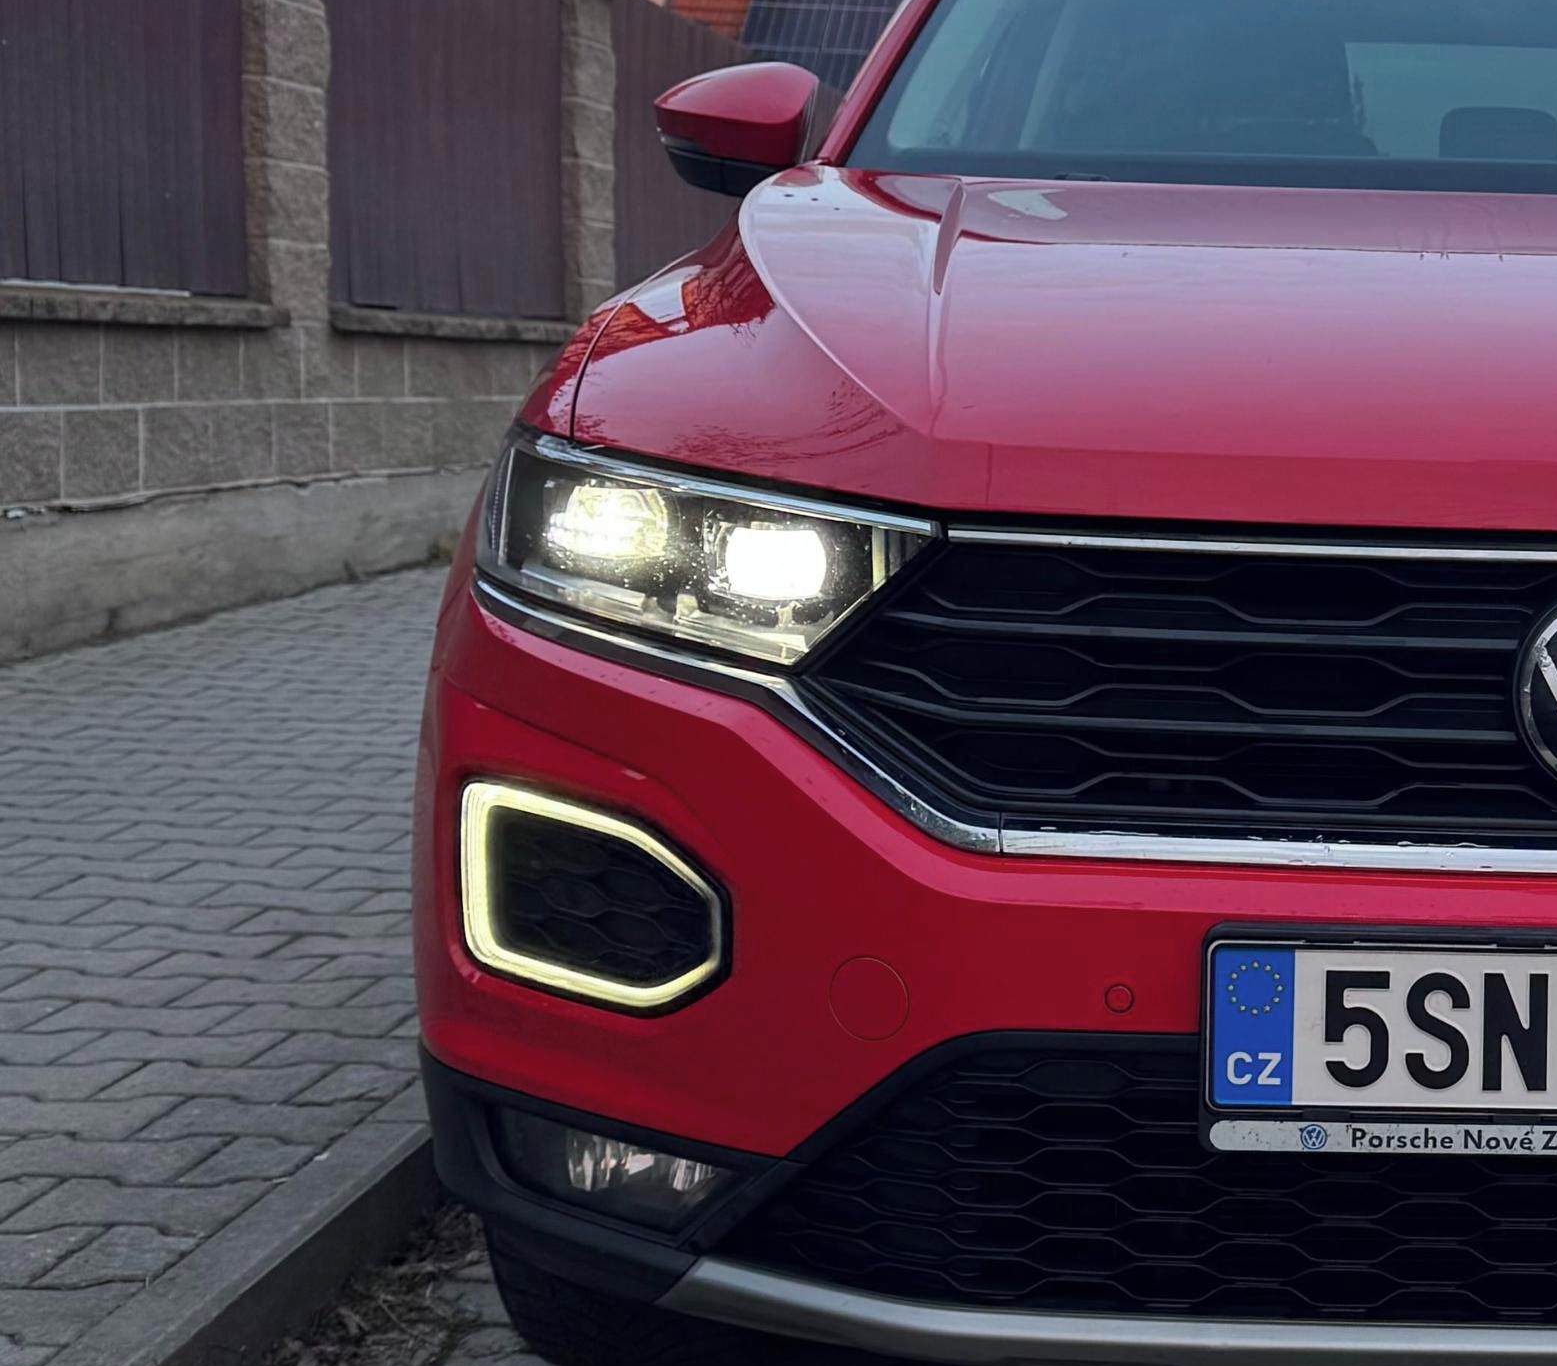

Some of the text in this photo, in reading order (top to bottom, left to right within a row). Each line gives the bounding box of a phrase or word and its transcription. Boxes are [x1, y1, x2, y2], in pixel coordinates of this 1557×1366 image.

[1325, 970, 1548, 1091] 5SN
[1228, 1052, 1280, 1084] CZ
[1351, 1127, 1453, 1151] Porsche
[1463, 1129, 1533, 1151] Nové
